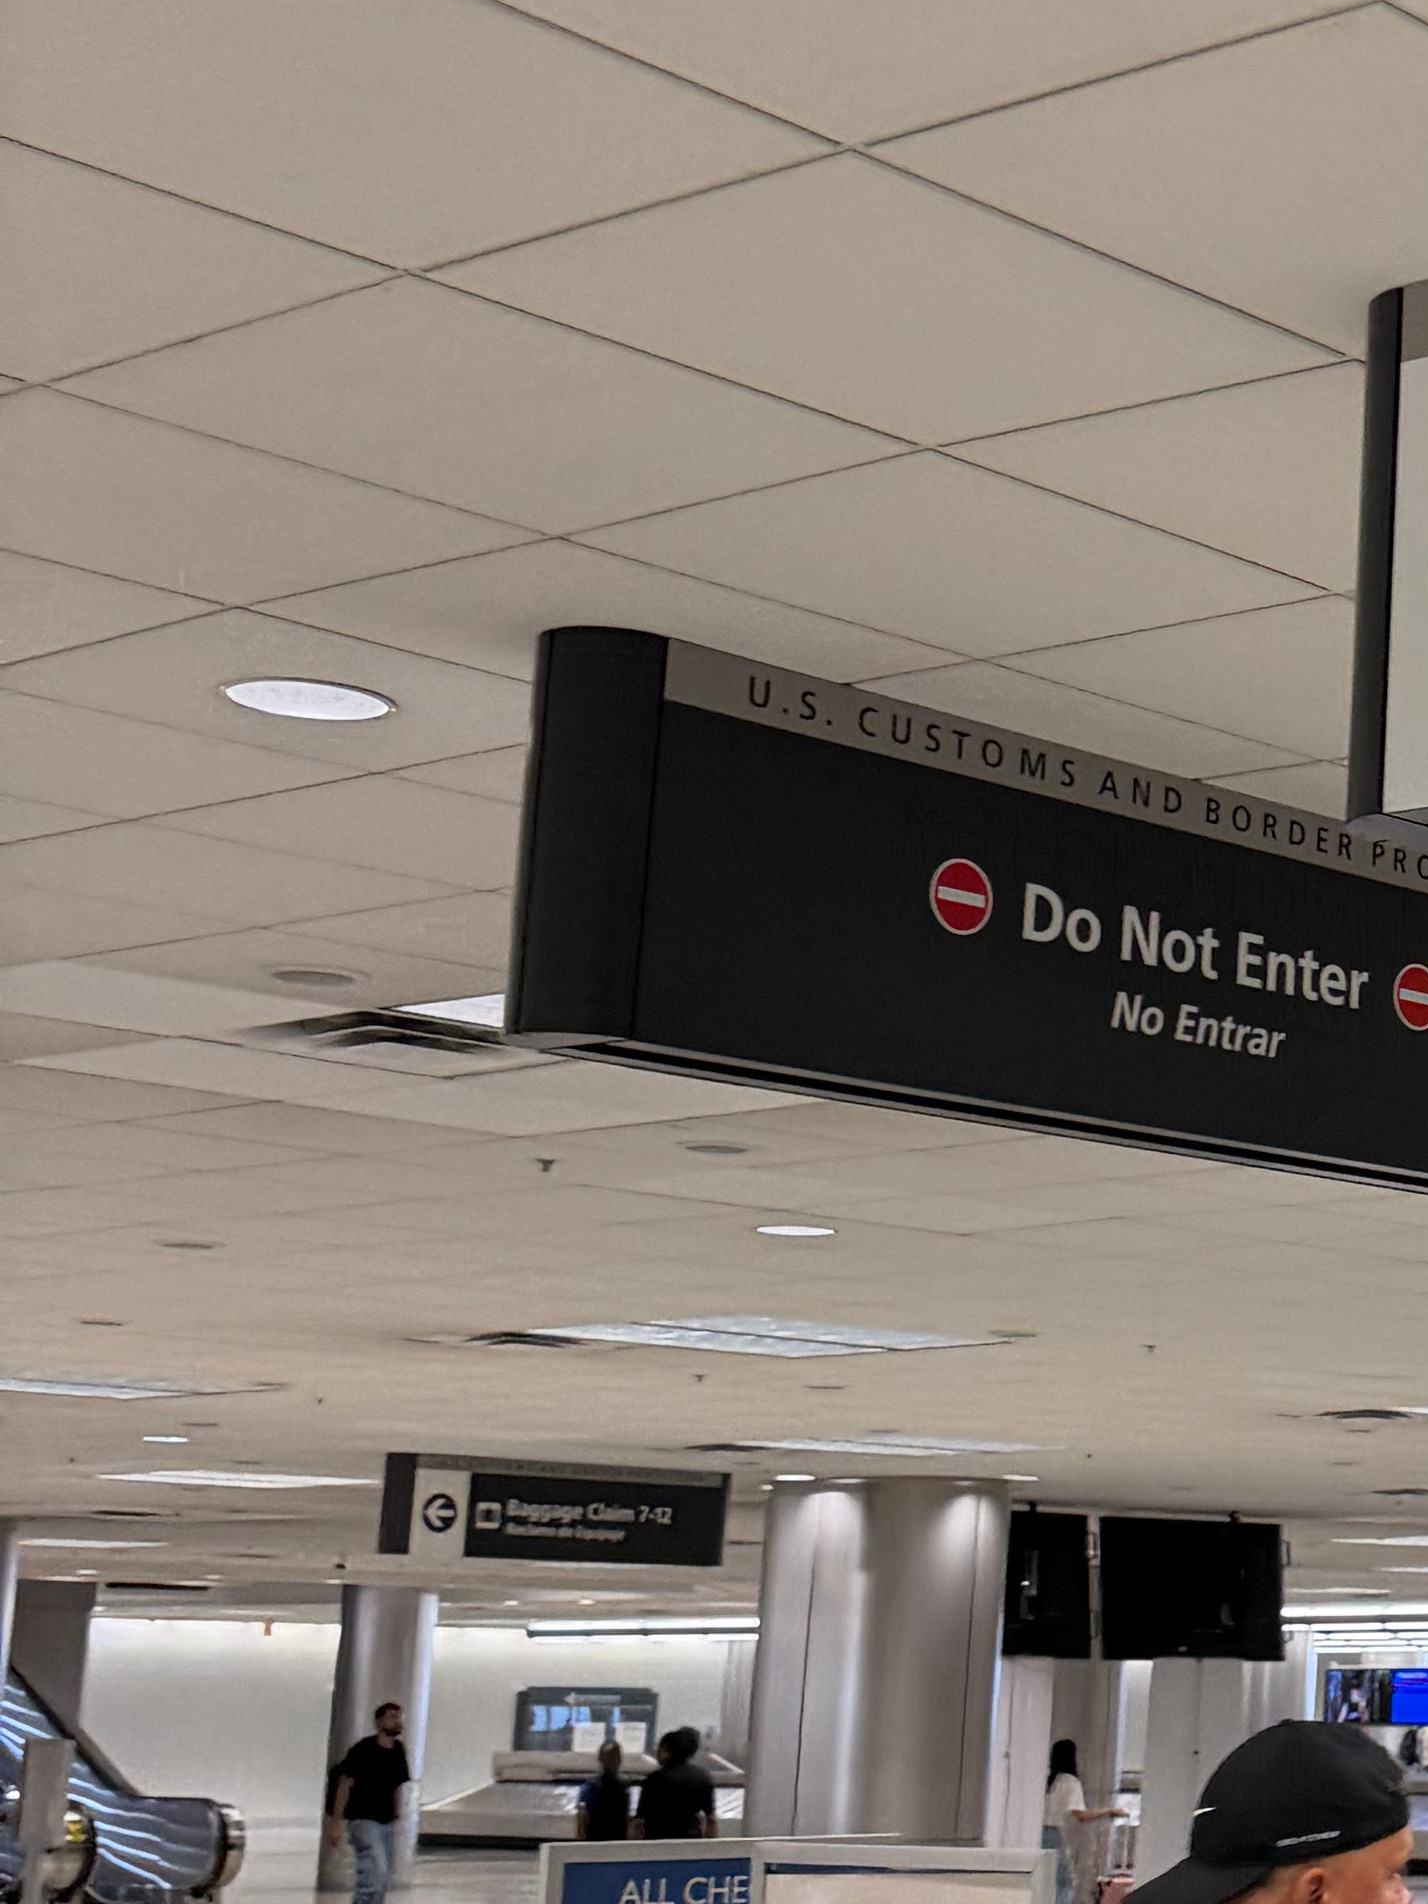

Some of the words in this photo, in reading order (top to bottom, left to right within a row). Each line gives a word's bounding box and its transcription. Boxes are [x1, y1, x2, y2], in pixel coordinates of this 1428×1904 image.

[748, 675, 834, 727] U.S.
[858, 706, 1076, 788] CUSTOMS
[1097, 771, 1183, 814] AND
[1205, 797, 1353, 861] BORDER
[1021, 882, 1102, 952] Do
[1120, 904, 1221, 980] Not
[1235, 930, 1370, 1010] Enter
[1110, 991, 1165, 1036] No
[1173, 1003, 1287, 1058] Entrar
